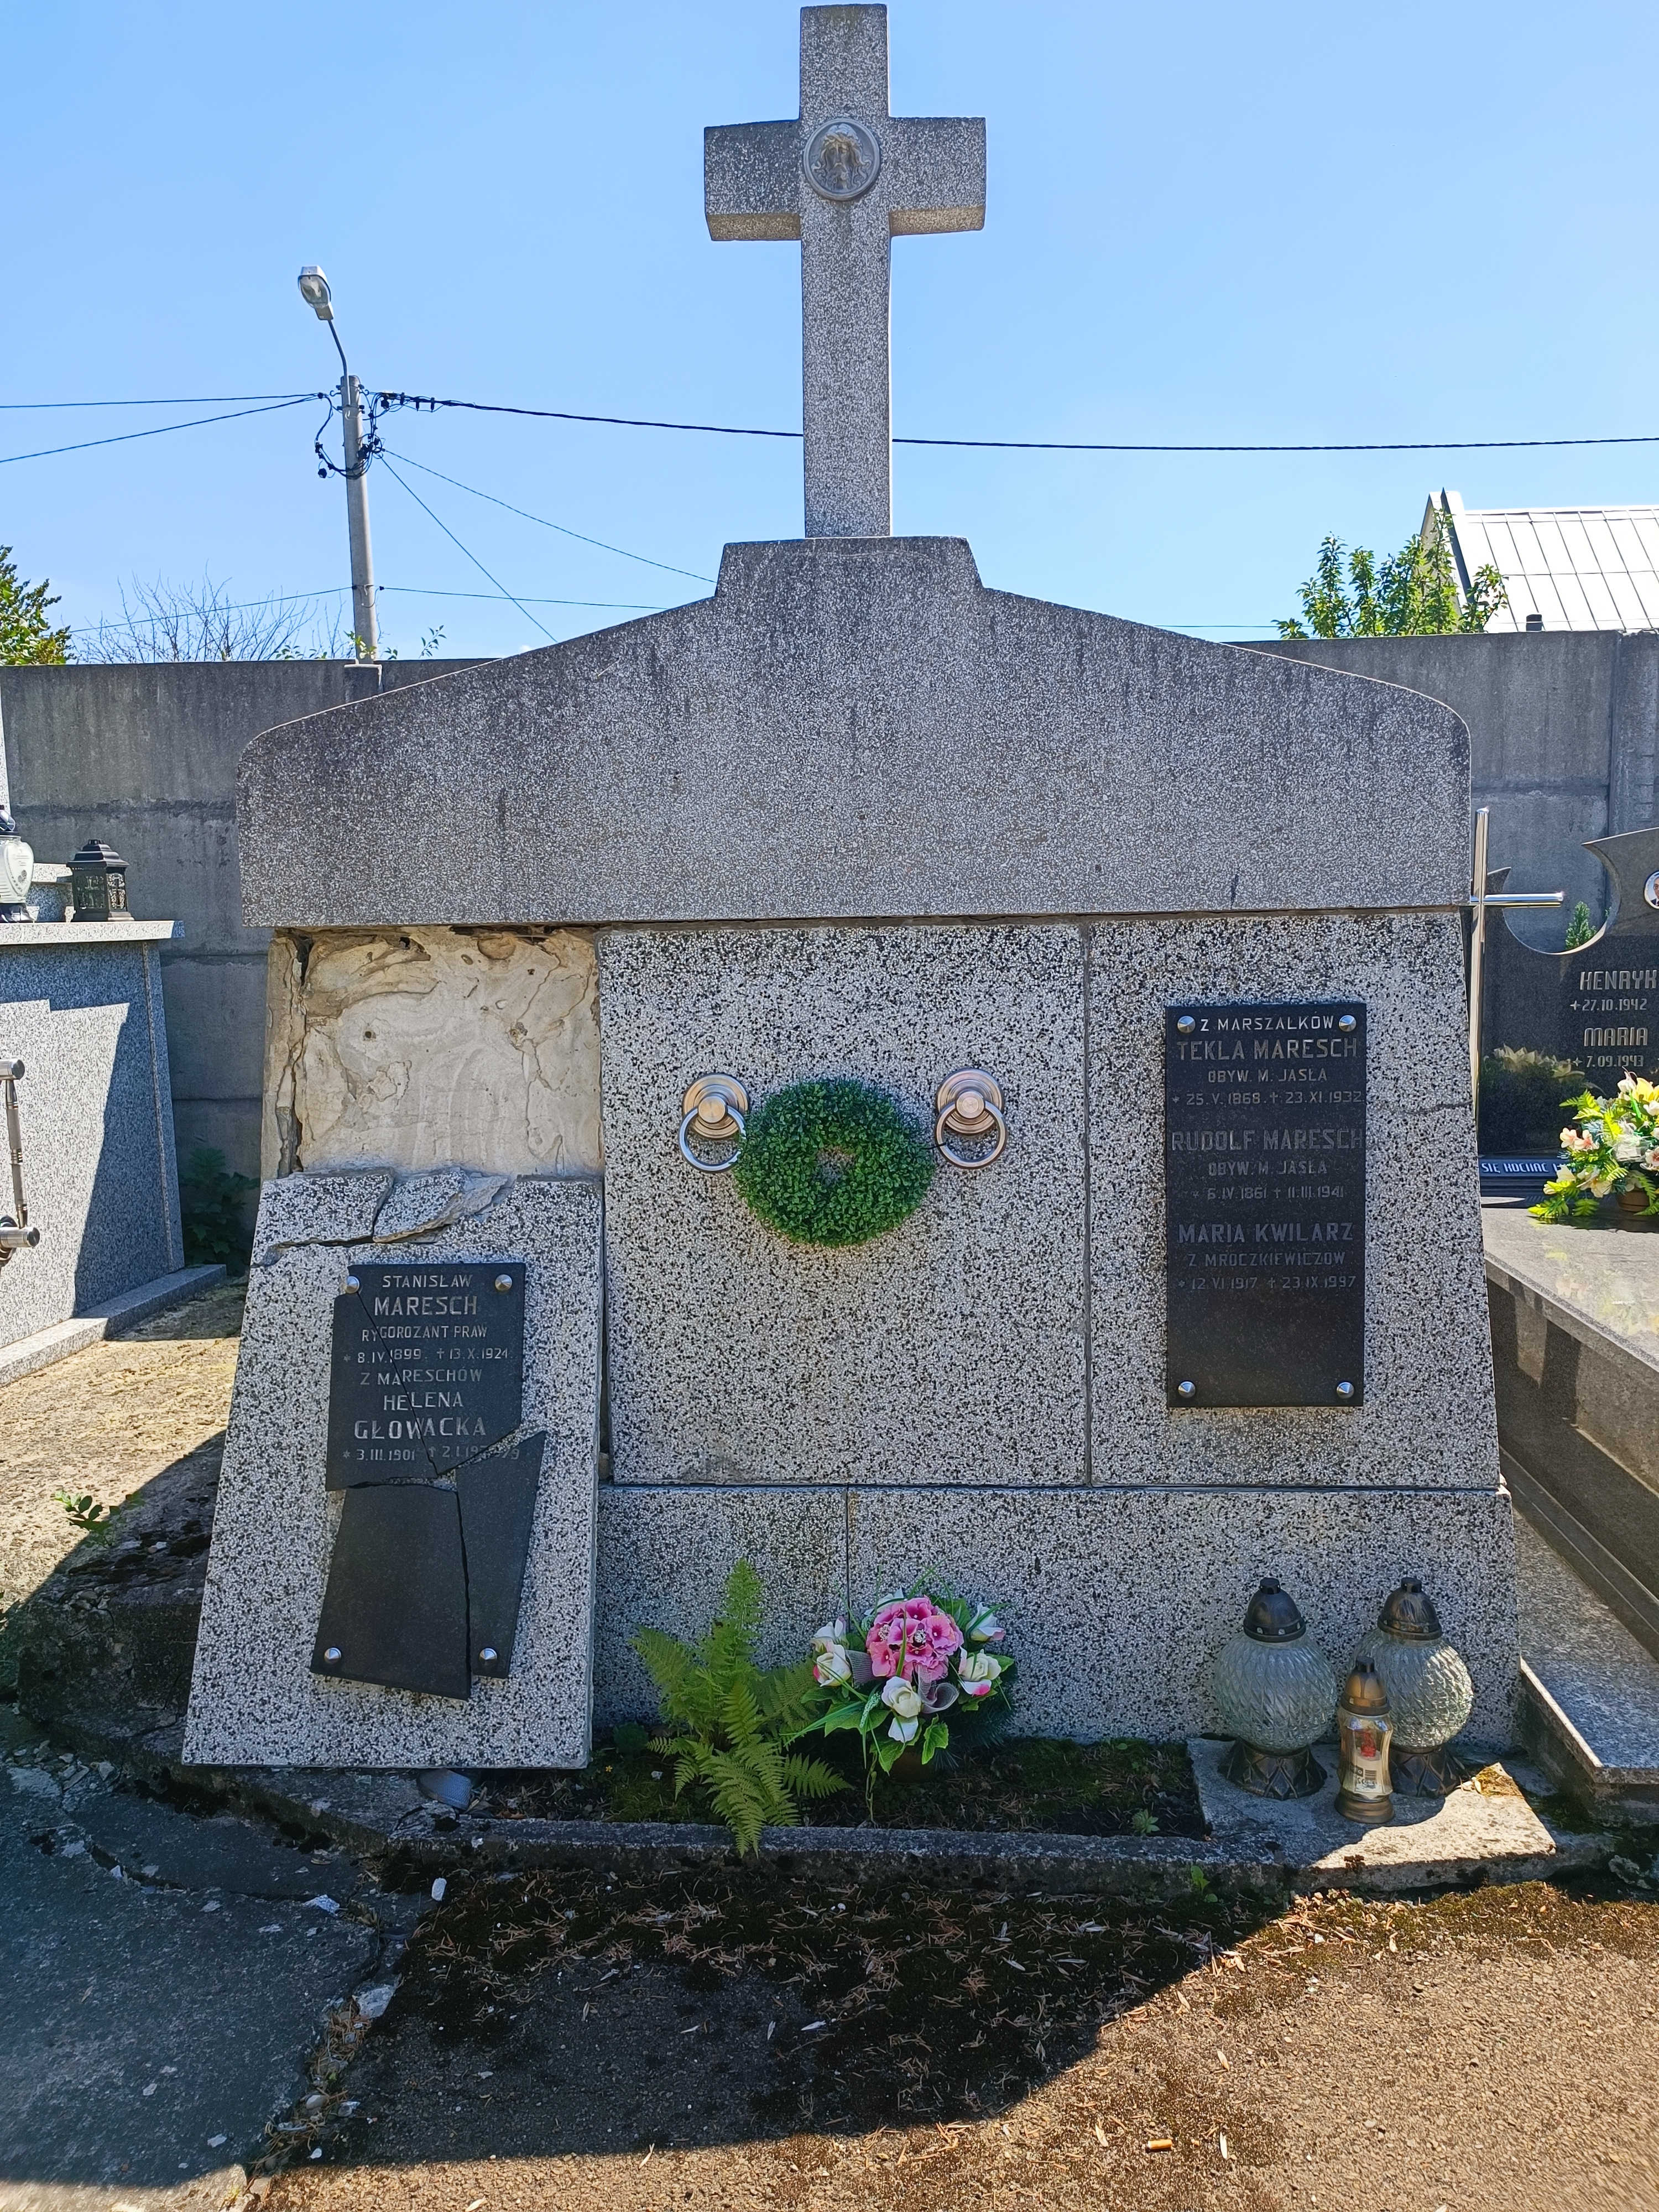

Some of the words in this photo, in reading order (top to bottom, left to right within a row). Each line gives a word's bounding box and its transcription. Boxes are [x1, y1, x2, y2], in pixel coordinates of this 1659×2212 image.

[1580, 970, 1657, 990] HENRYK
[1582, 998, 1647, 1011] 27.10.1942
[1200, 1019, 1209, 1031] Z
[1584, 1027, 1648, 1047] MARIA
[1176, 1040, 1245, 1060] TEKLA
[1254, 1037, 1357, 1060] MARESCH
[1587, 1055, 1644, 1067] 7.09.1943
[1208, 1070, 1252, 1083] OBYW.
[1279, 1067, 1327, 1082] JASŁA
[1172, 1130, 1255, 1151] RUDOLF
[1264, 1128, 1363, 1150] MARESCH
[1208, 1161, 1254, 1176] OBYW.
[1277, 1161, 1327, 1175] JASŁA
[1481, 1163, 1501, 1173] SIĘ
[1179, 1223, 1245, 1243] MARIA
[1255, 1222, 1353, 1242] KWILARZ
[1188, 1253, 1197, 1266] Z
[374, 1296, 477, 1316] MARESCH
[362, 1326, 448, 1342] RYGOROZANT
[453, 1325, 487, 1338] PRAW
[360, 1373, 370, 1385] Z
[377, 1366, 482, 1385] MARESCHÓW
[384, 1391, 463, 1410] HELENA
[354, 1417, 486, 1439] GŁOWACKA
